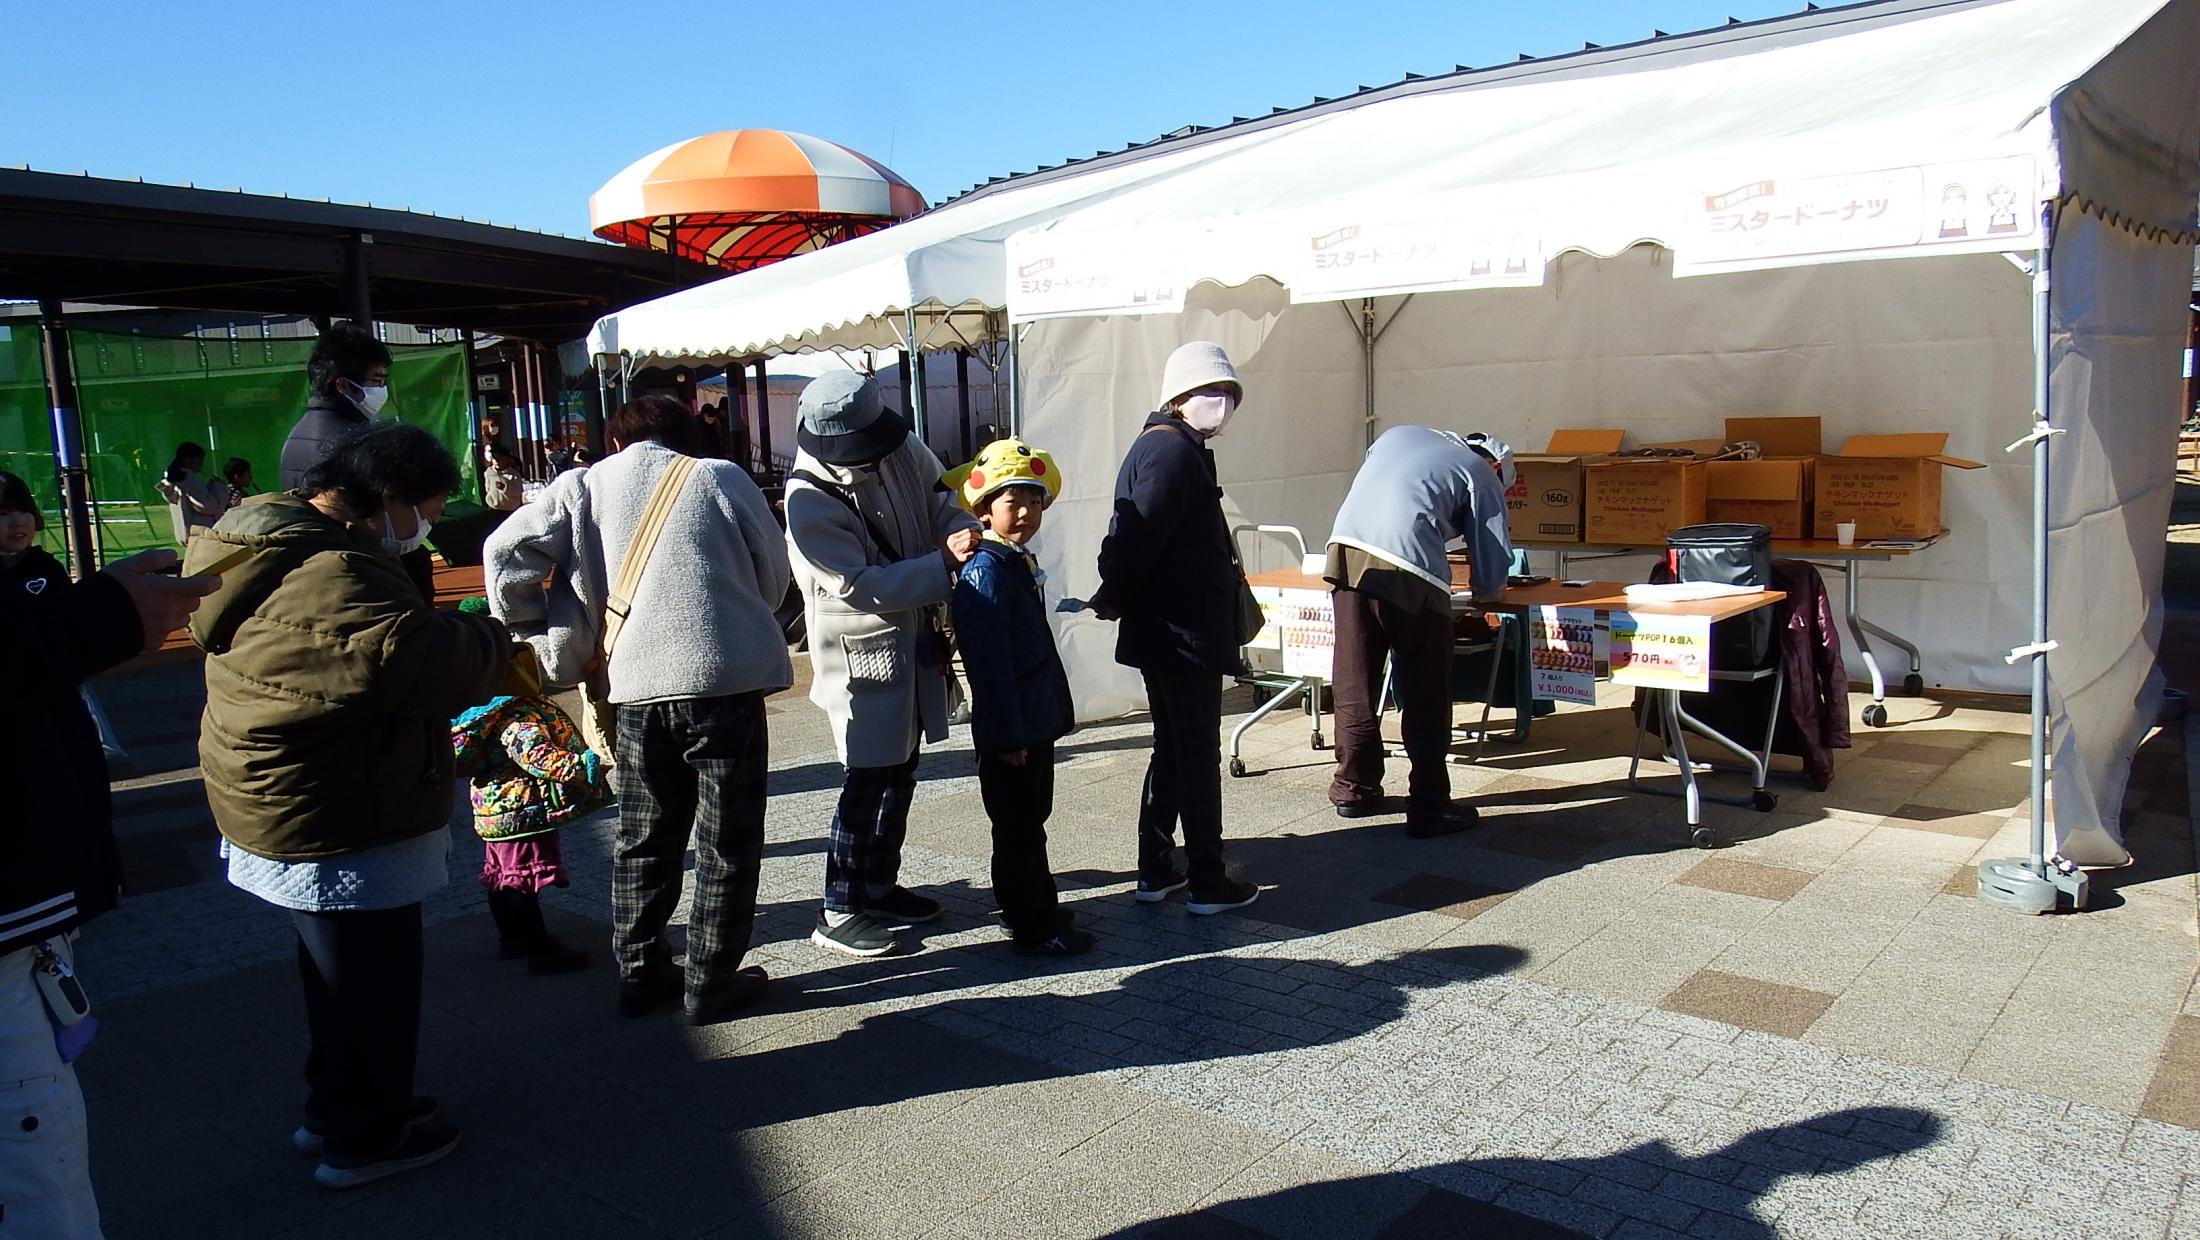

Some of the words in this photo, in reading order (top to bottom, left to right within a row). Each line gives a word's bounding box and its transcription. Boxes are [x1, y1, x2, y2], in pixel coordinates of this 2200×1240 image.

[1710, 198, 1889, 232] ミスタードーナツ
[1545, 493, 1569, 504] 160g
[1826, 490, 1909, 499] チキンマックナゲット
[1596, 496, 1673, 505] チキンマックナゲット
[1623, 651, 1660, 665] 570円
